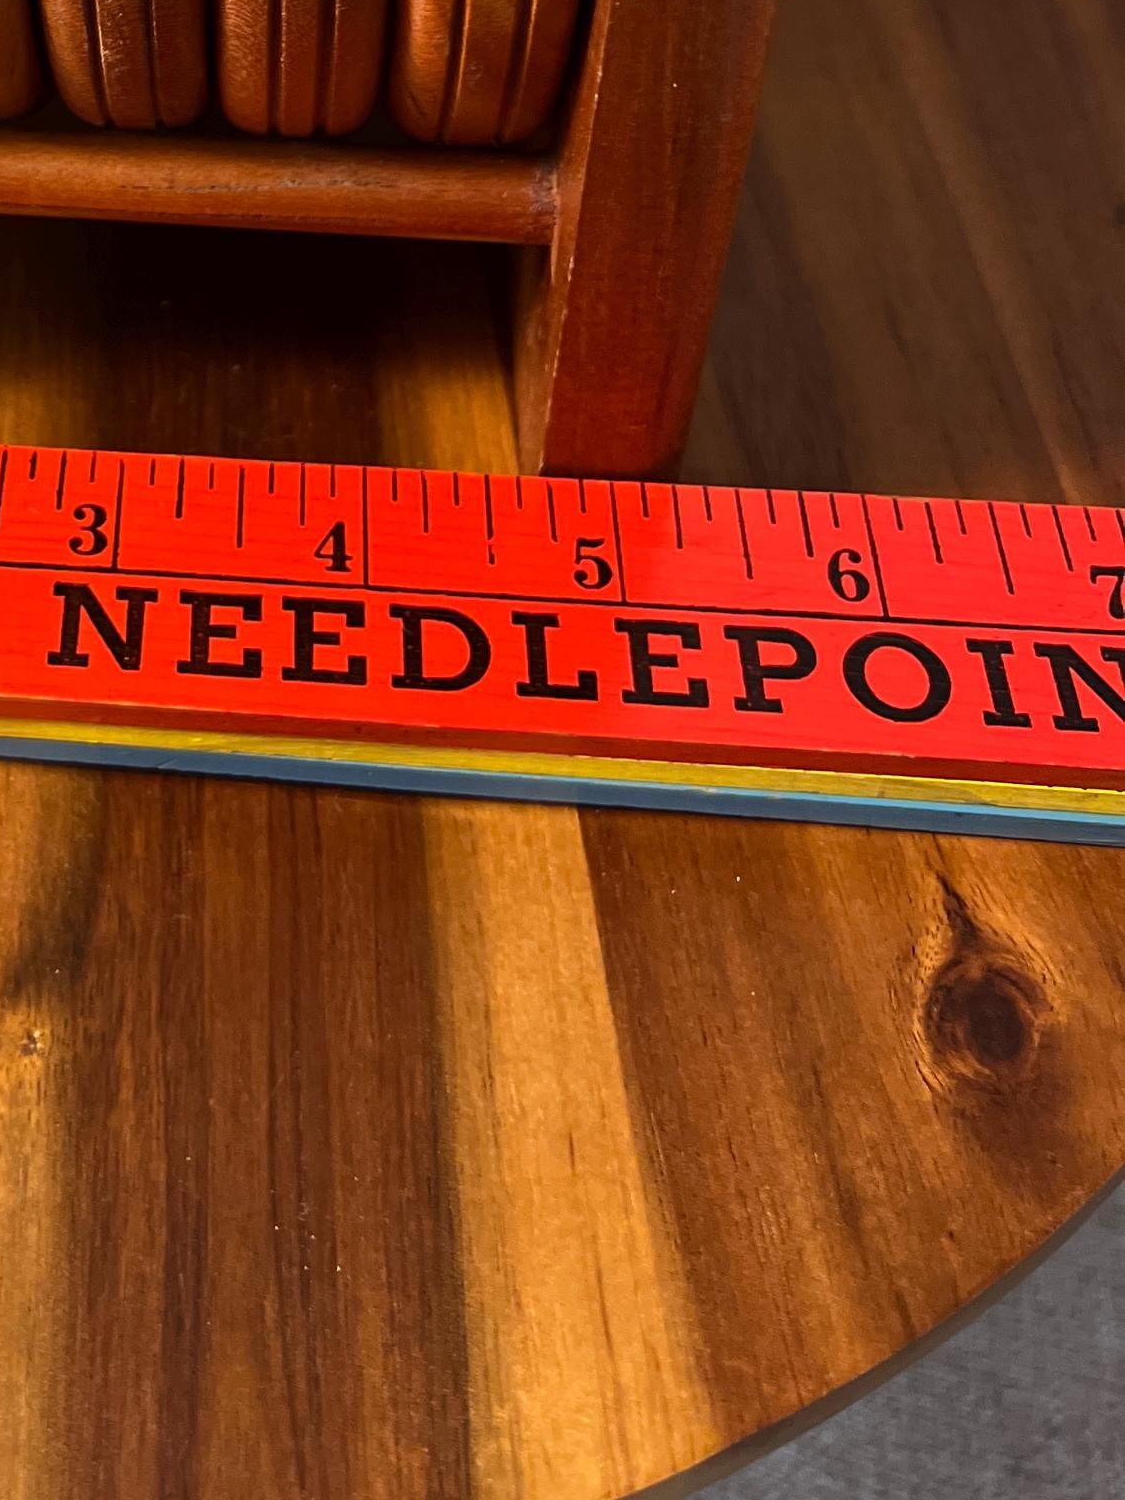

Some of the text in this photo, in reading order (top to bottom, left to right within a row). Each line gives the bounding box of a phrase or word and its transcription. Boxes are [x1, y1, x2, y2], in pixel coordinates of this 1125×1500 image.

[69, 504, 108, 556] 3
[313, 521, 354, 573] 4
[574, 538, 613, 590] 5
[827, 549, 870, 602] 6
[1089, 566, 1125, 620] 7
